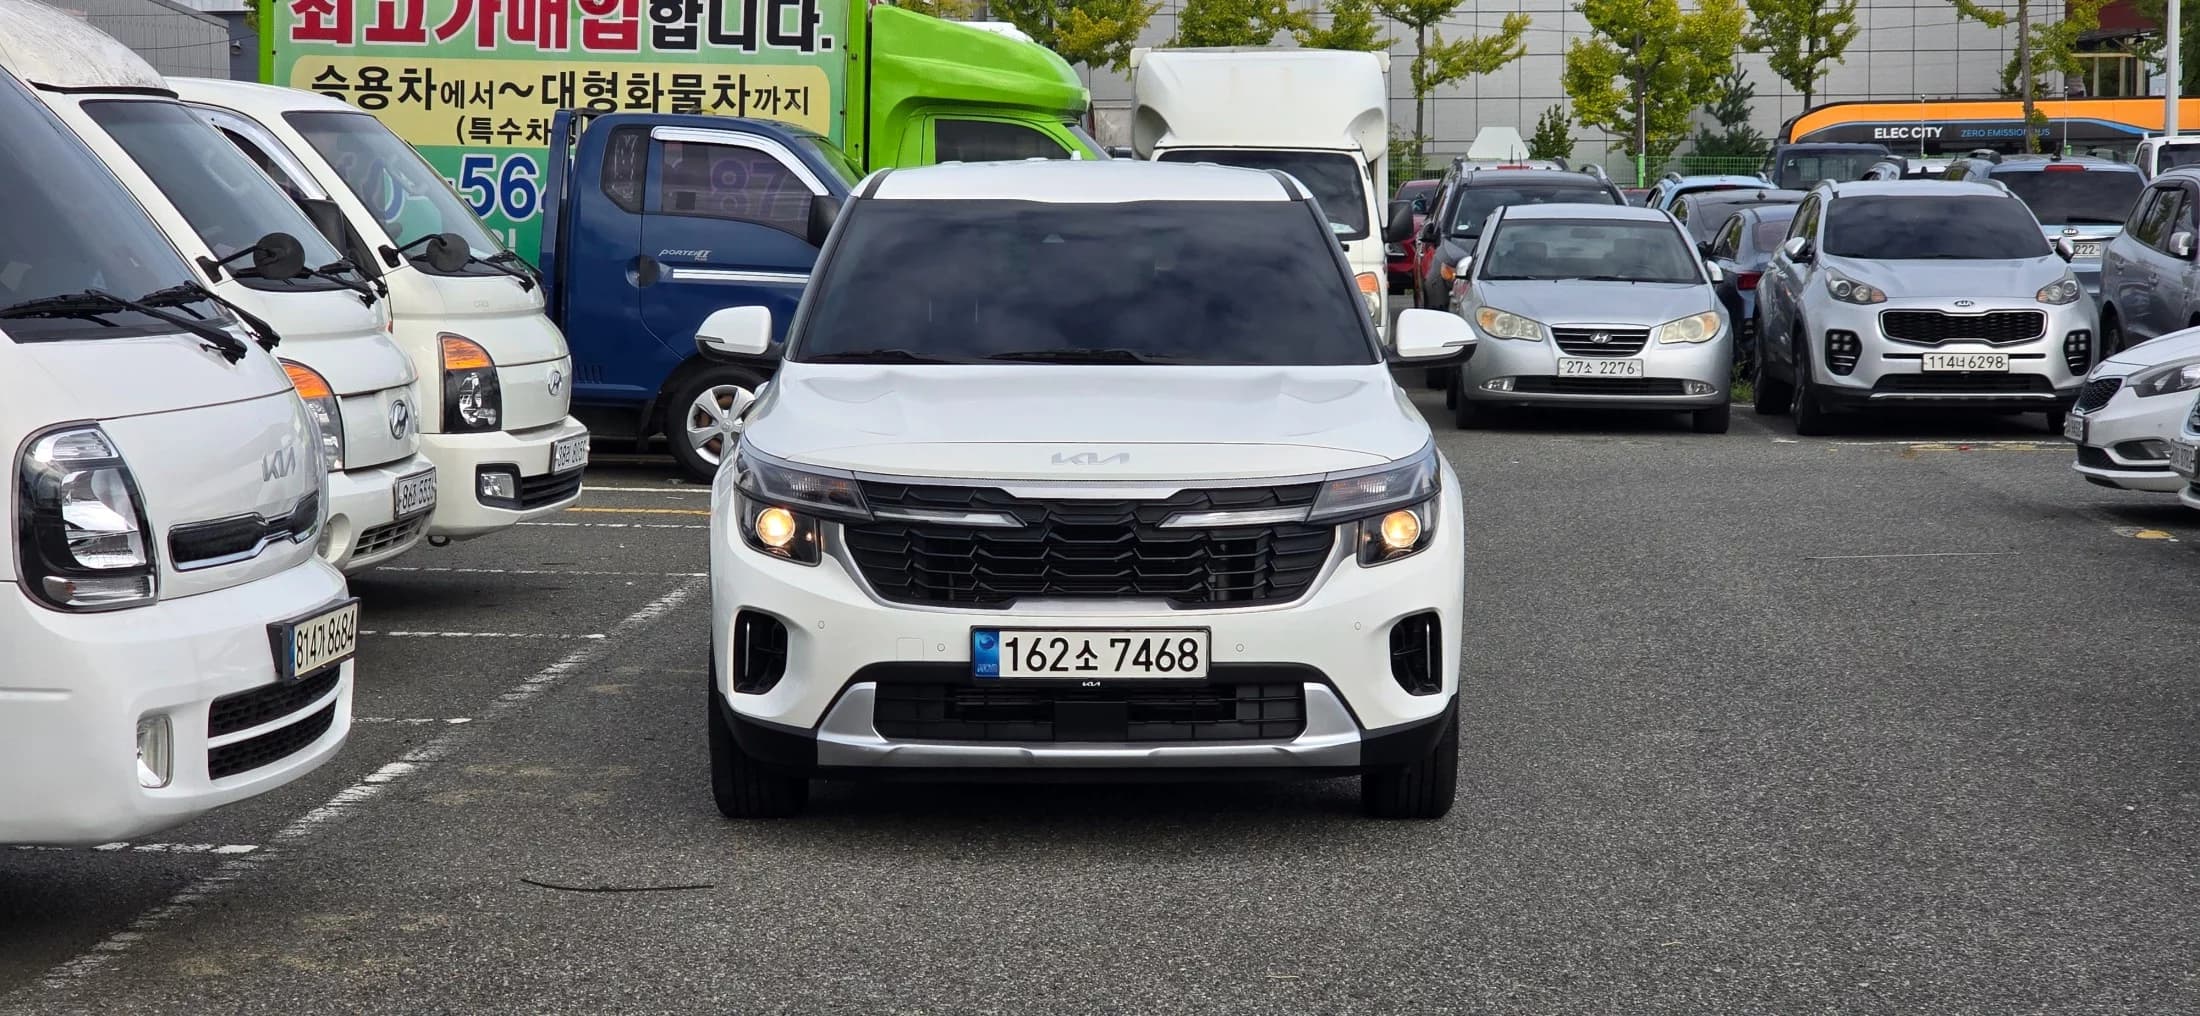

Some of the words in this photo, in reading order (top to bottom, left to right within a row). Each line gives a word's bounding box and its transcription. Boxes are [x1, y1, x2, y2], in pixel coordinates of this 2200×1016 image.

[456, 115, 576, 146] (특수차
[1874, 127, 1909, 139] ELEC
[1911, 126, 1943, 138] CITY
[1961, 129, 1986, 138] ZERO
[1566, 360, 1593, 374] 27소
[1600, 361, 1635, 375] 2276
[1928, 355, 1965, 369] 114너
[1968, 355, 2004, 369] 6298
[296, 623, 325, 669] 814가
[327, 609, 355, 656] 8684
[1005, 636, 1099, 672] 162소
[1109, 637, 1199, 672] 7468
